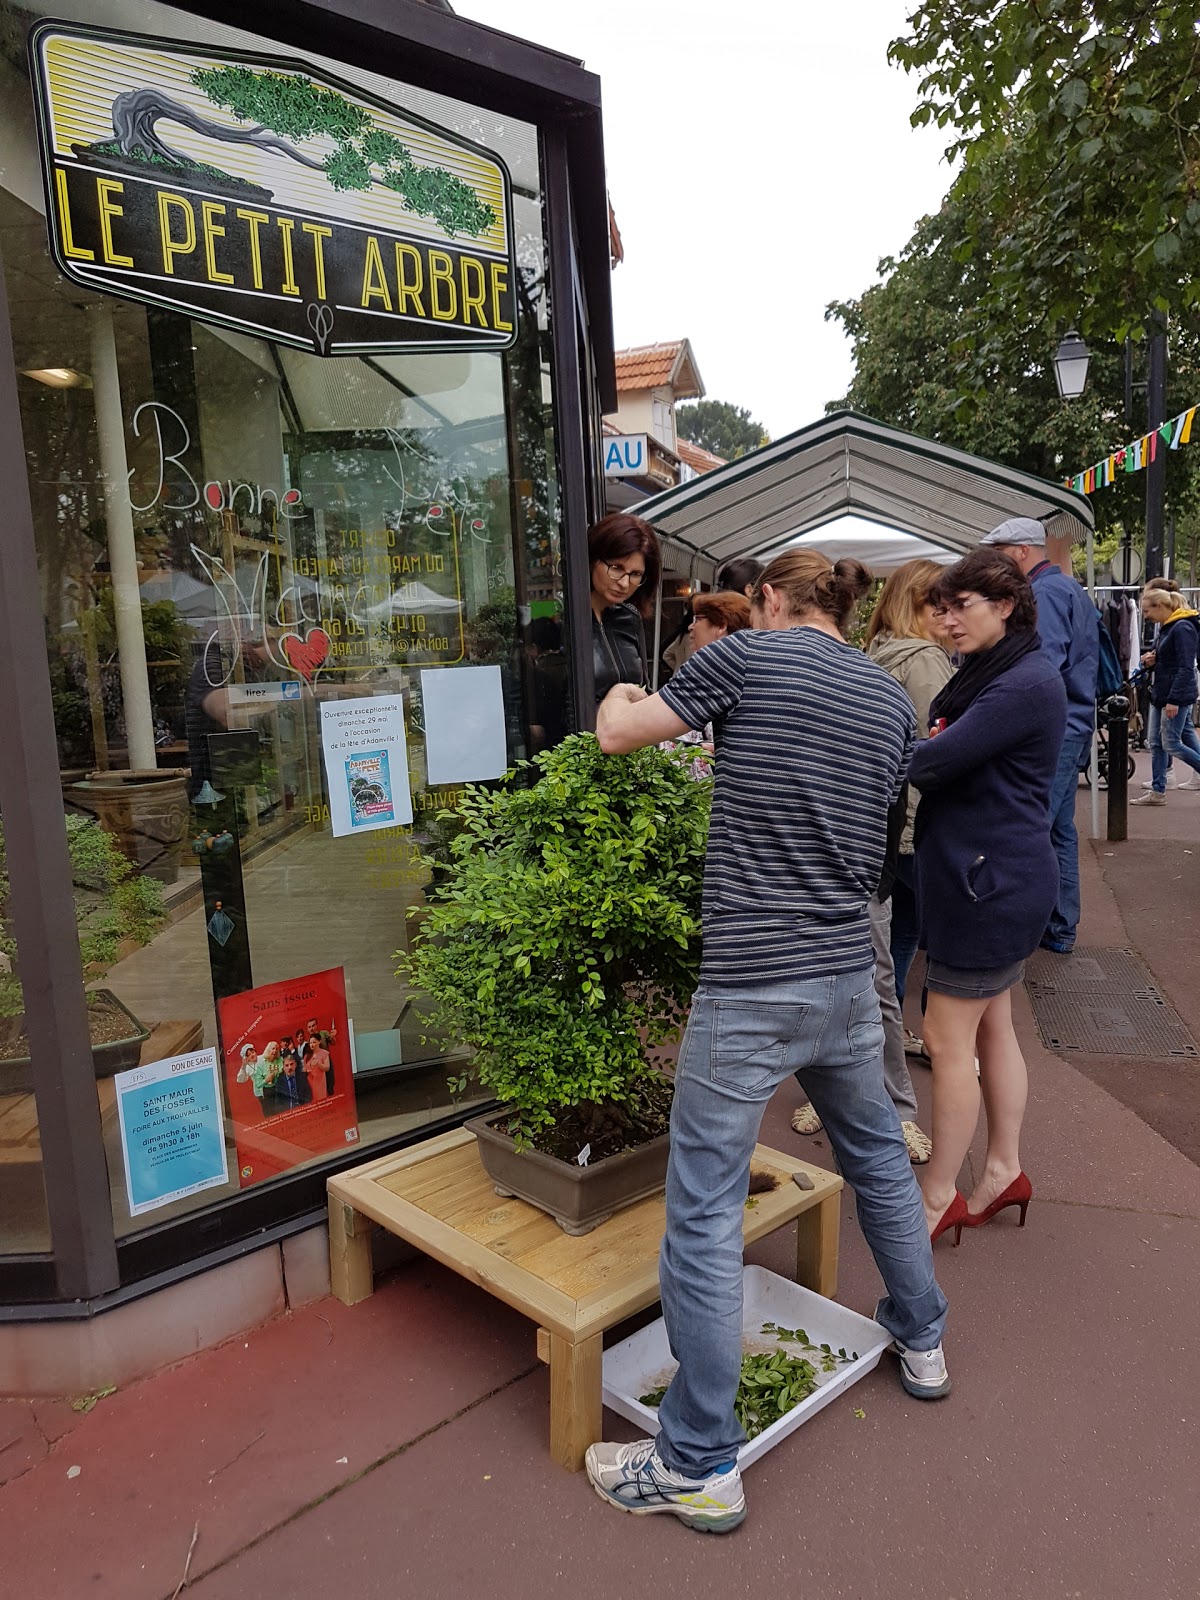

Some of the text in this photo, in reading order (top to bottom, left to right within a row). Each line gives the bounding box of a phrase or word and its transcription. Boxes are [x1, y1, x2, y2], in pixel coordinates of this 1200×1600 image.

[55, 169, 513, 331] LE PETIT ARBRE
[128, 402, 308, 519] Bonne
[246, 688, 266, 697] tirez
[324, 705, 398, 719] Ouverture exceptionnelle
[338, 718, 366, 728] dimanche
[331, 742, 338, 750] de
[253, 997, 281, 1013] Sans
[284, 989, 316, 1004] issue
[171, 1055, 213, 1072] DON DE SANG
[143, 1087, 194, 1108] SAINT MAUR
[143, 1096, 196, 1118] DES FOSSES
[132, 1105, 210, 1133] FOIRE AUX TROUVAILLES
[142, 1128, 180, 1146] dimanche
[188, 1121, 203, 1134] juin
[147, 1146, 157, 1154] de
[158, 1138, 178, 1150] 9h30
[186, 1132, 200, 1141] 18h
